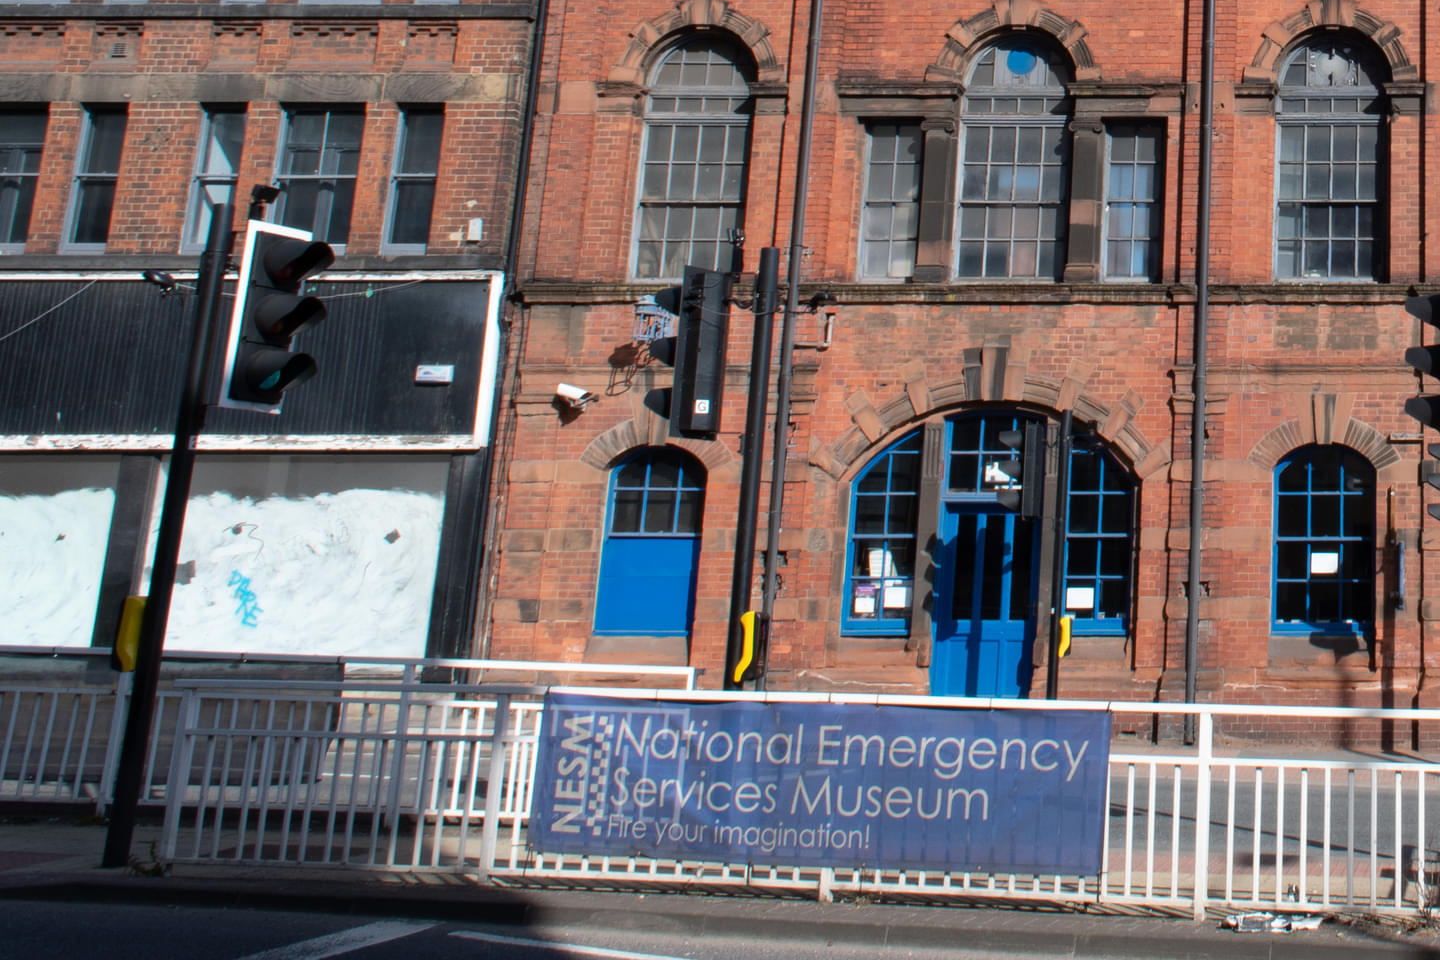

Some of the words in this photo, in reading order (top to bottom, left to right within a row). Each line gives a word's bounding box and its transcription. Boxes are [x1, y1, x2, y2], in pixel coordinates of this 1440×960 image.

[551, 715, 595, 834] NESM
[614, 717, 803, 765] National
[816, 726, 1089, 781] Emergency
[609, 767, 777, 814] Services
[790, 775, 989, 820] Museum
[605, 814, 646, 839] Fire
[651, 821, 709, 848] your
[713, 822, 870, 851] imagination!
